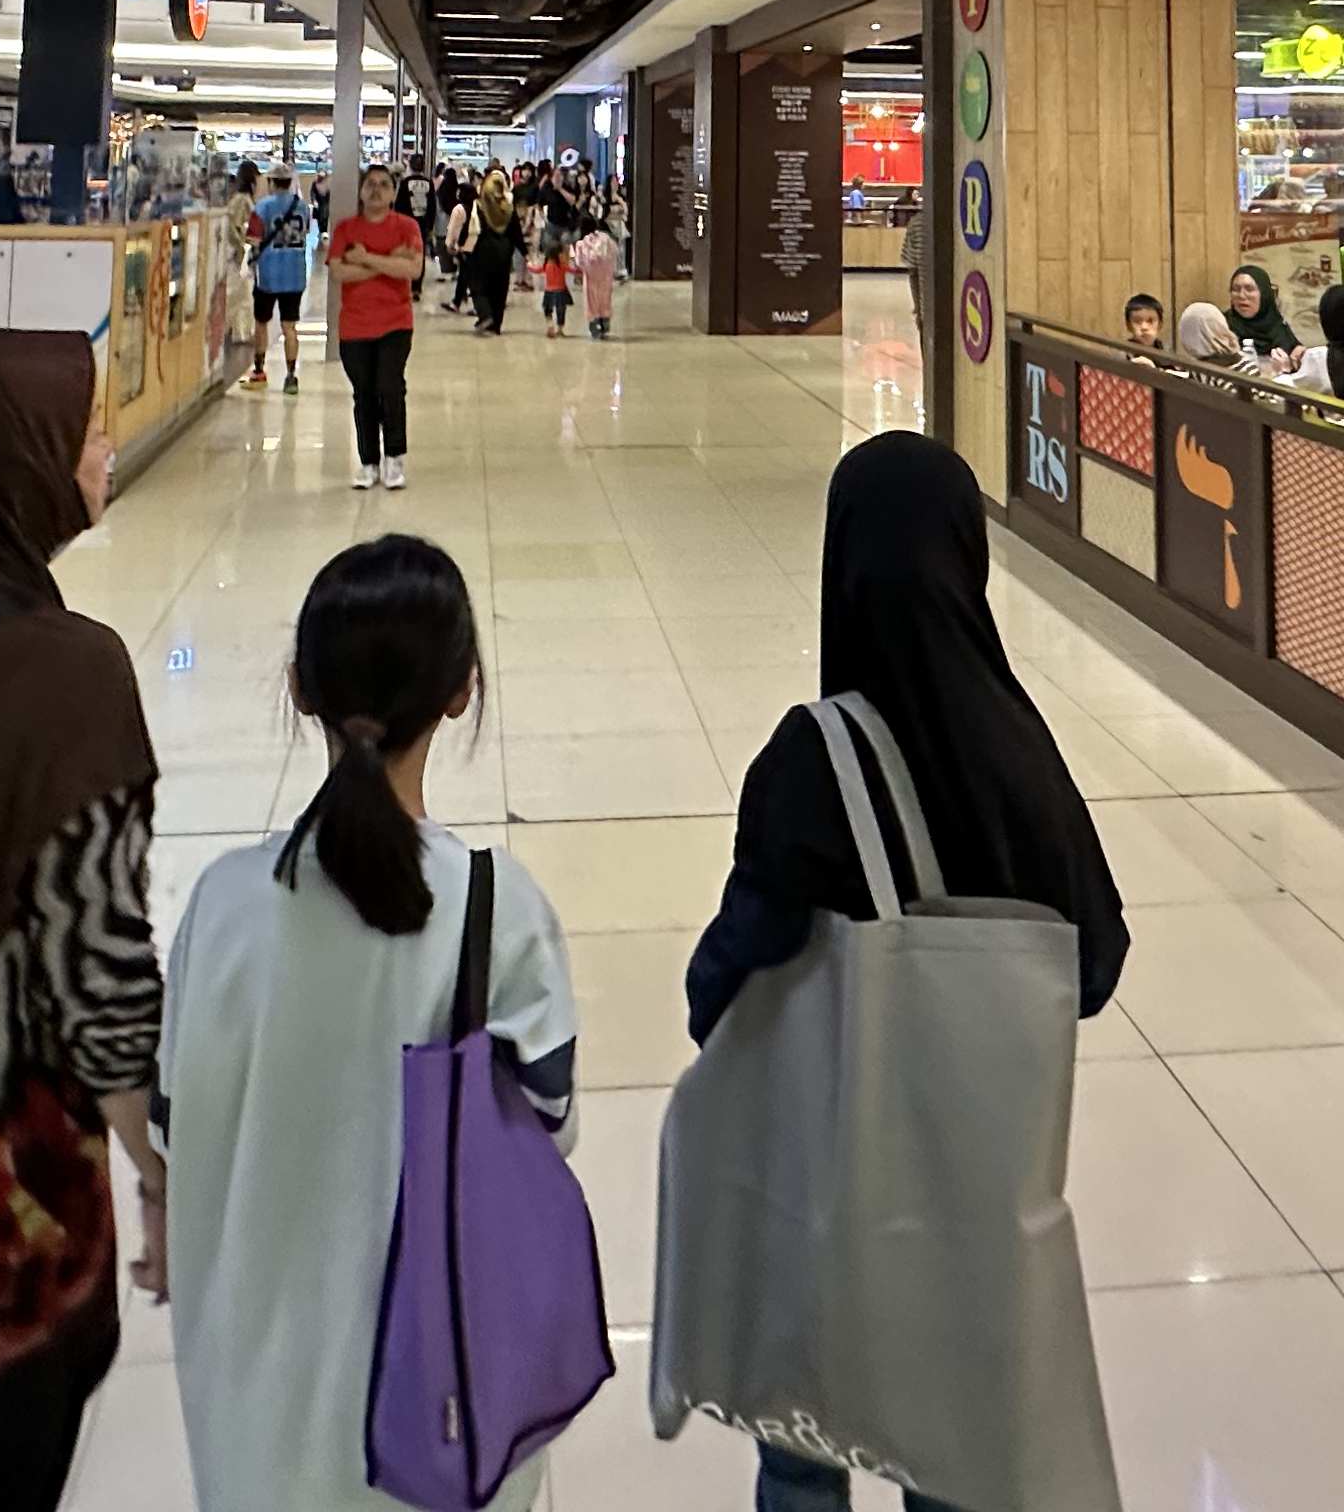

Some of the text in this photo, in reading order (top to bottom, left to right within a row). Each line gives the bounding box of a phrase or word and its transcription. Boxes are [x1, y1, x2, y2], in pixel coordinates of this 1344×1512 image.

[964, 177, 983, 236] R
[965, 287, 984, 348] S
[1025, 361, 1047, 426] T
[1025, 425, 1069, 504] RS
